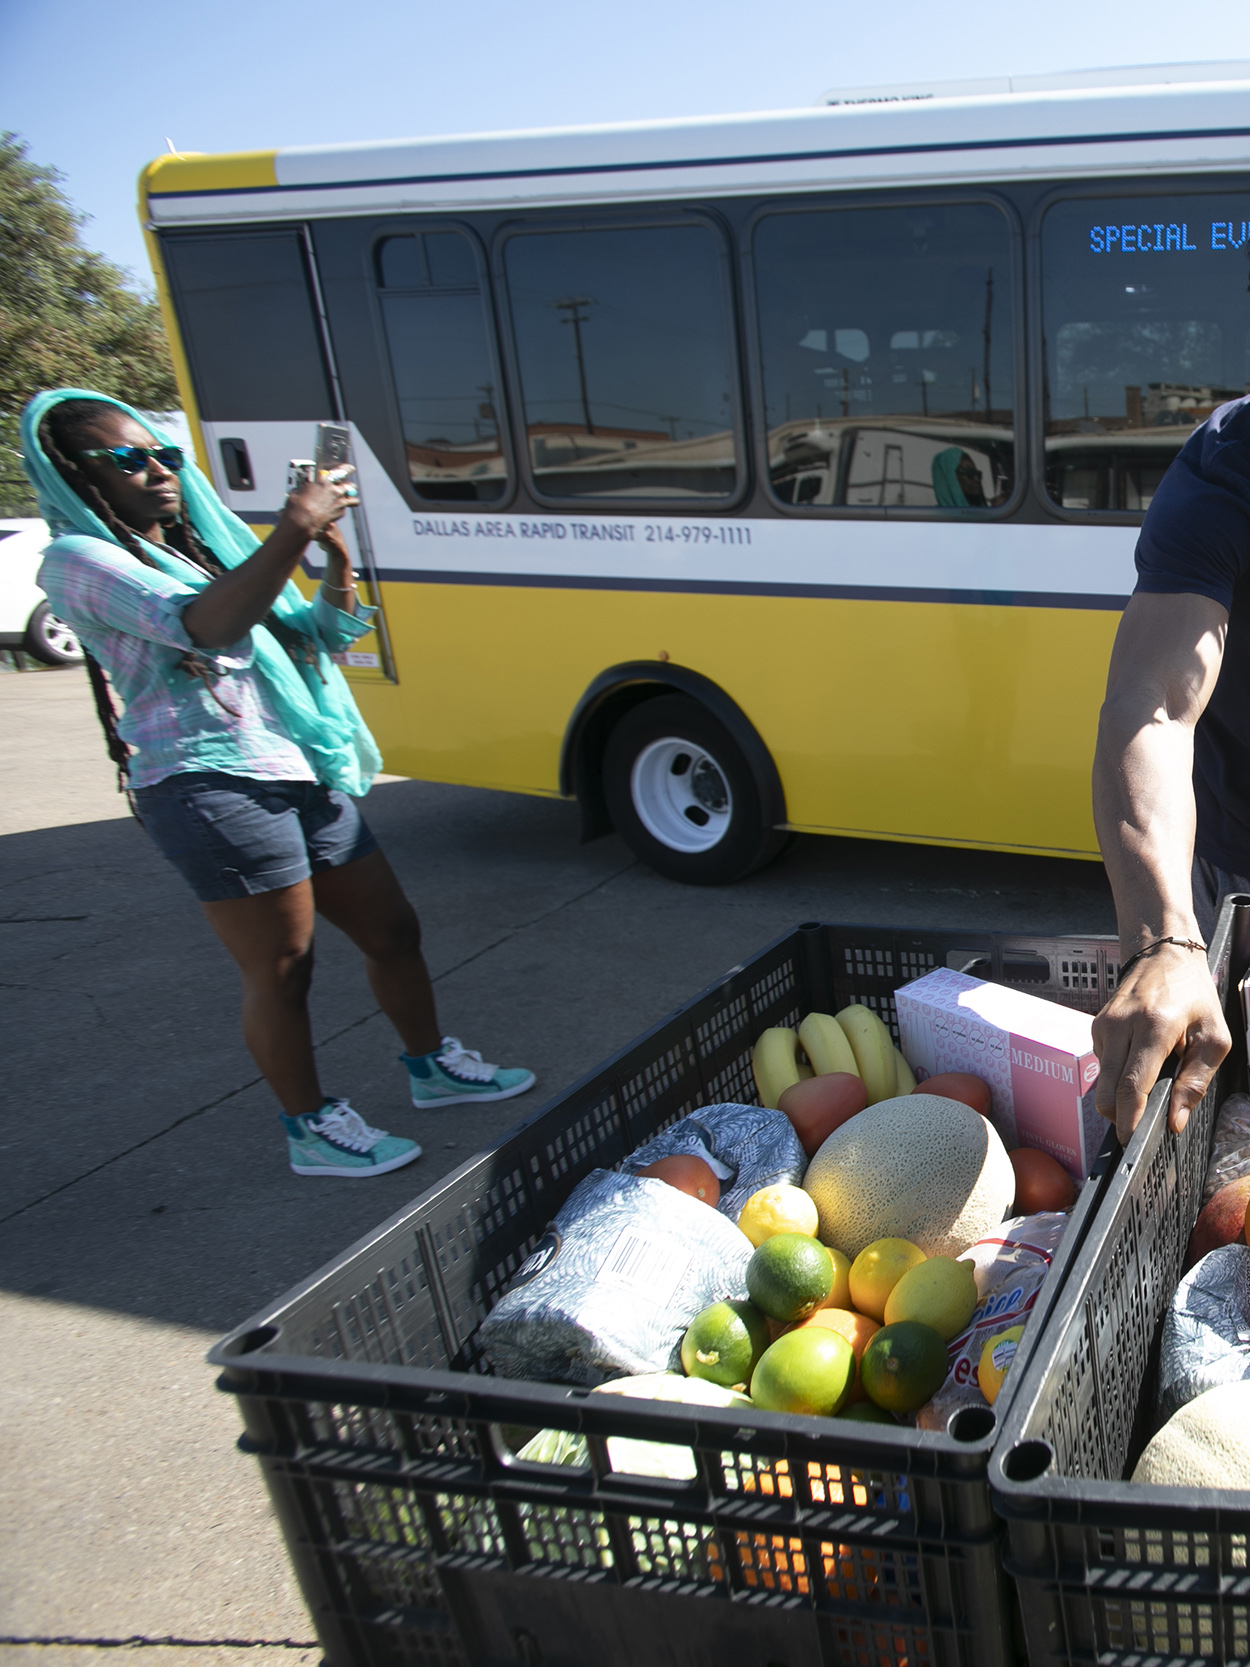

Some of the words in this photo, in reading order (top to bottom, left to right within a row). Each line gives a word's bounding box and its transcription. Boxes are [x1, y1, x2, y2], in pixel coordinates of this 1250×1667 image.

[1089, 223, 1197, 253] SPECIAL
[412, 519, 471, 538] DALLAS
[475, 521, 517, 539] AREA
[519, 522, 566, 540] RAPID
[570, 523, 634, 541] TRANSIT
[644, 524, 752, 545] 214-979-1111
[1011, 1047, 1075, 1085] MEDIUM
[1046, 1137, 1077, 1157] GLOVES
